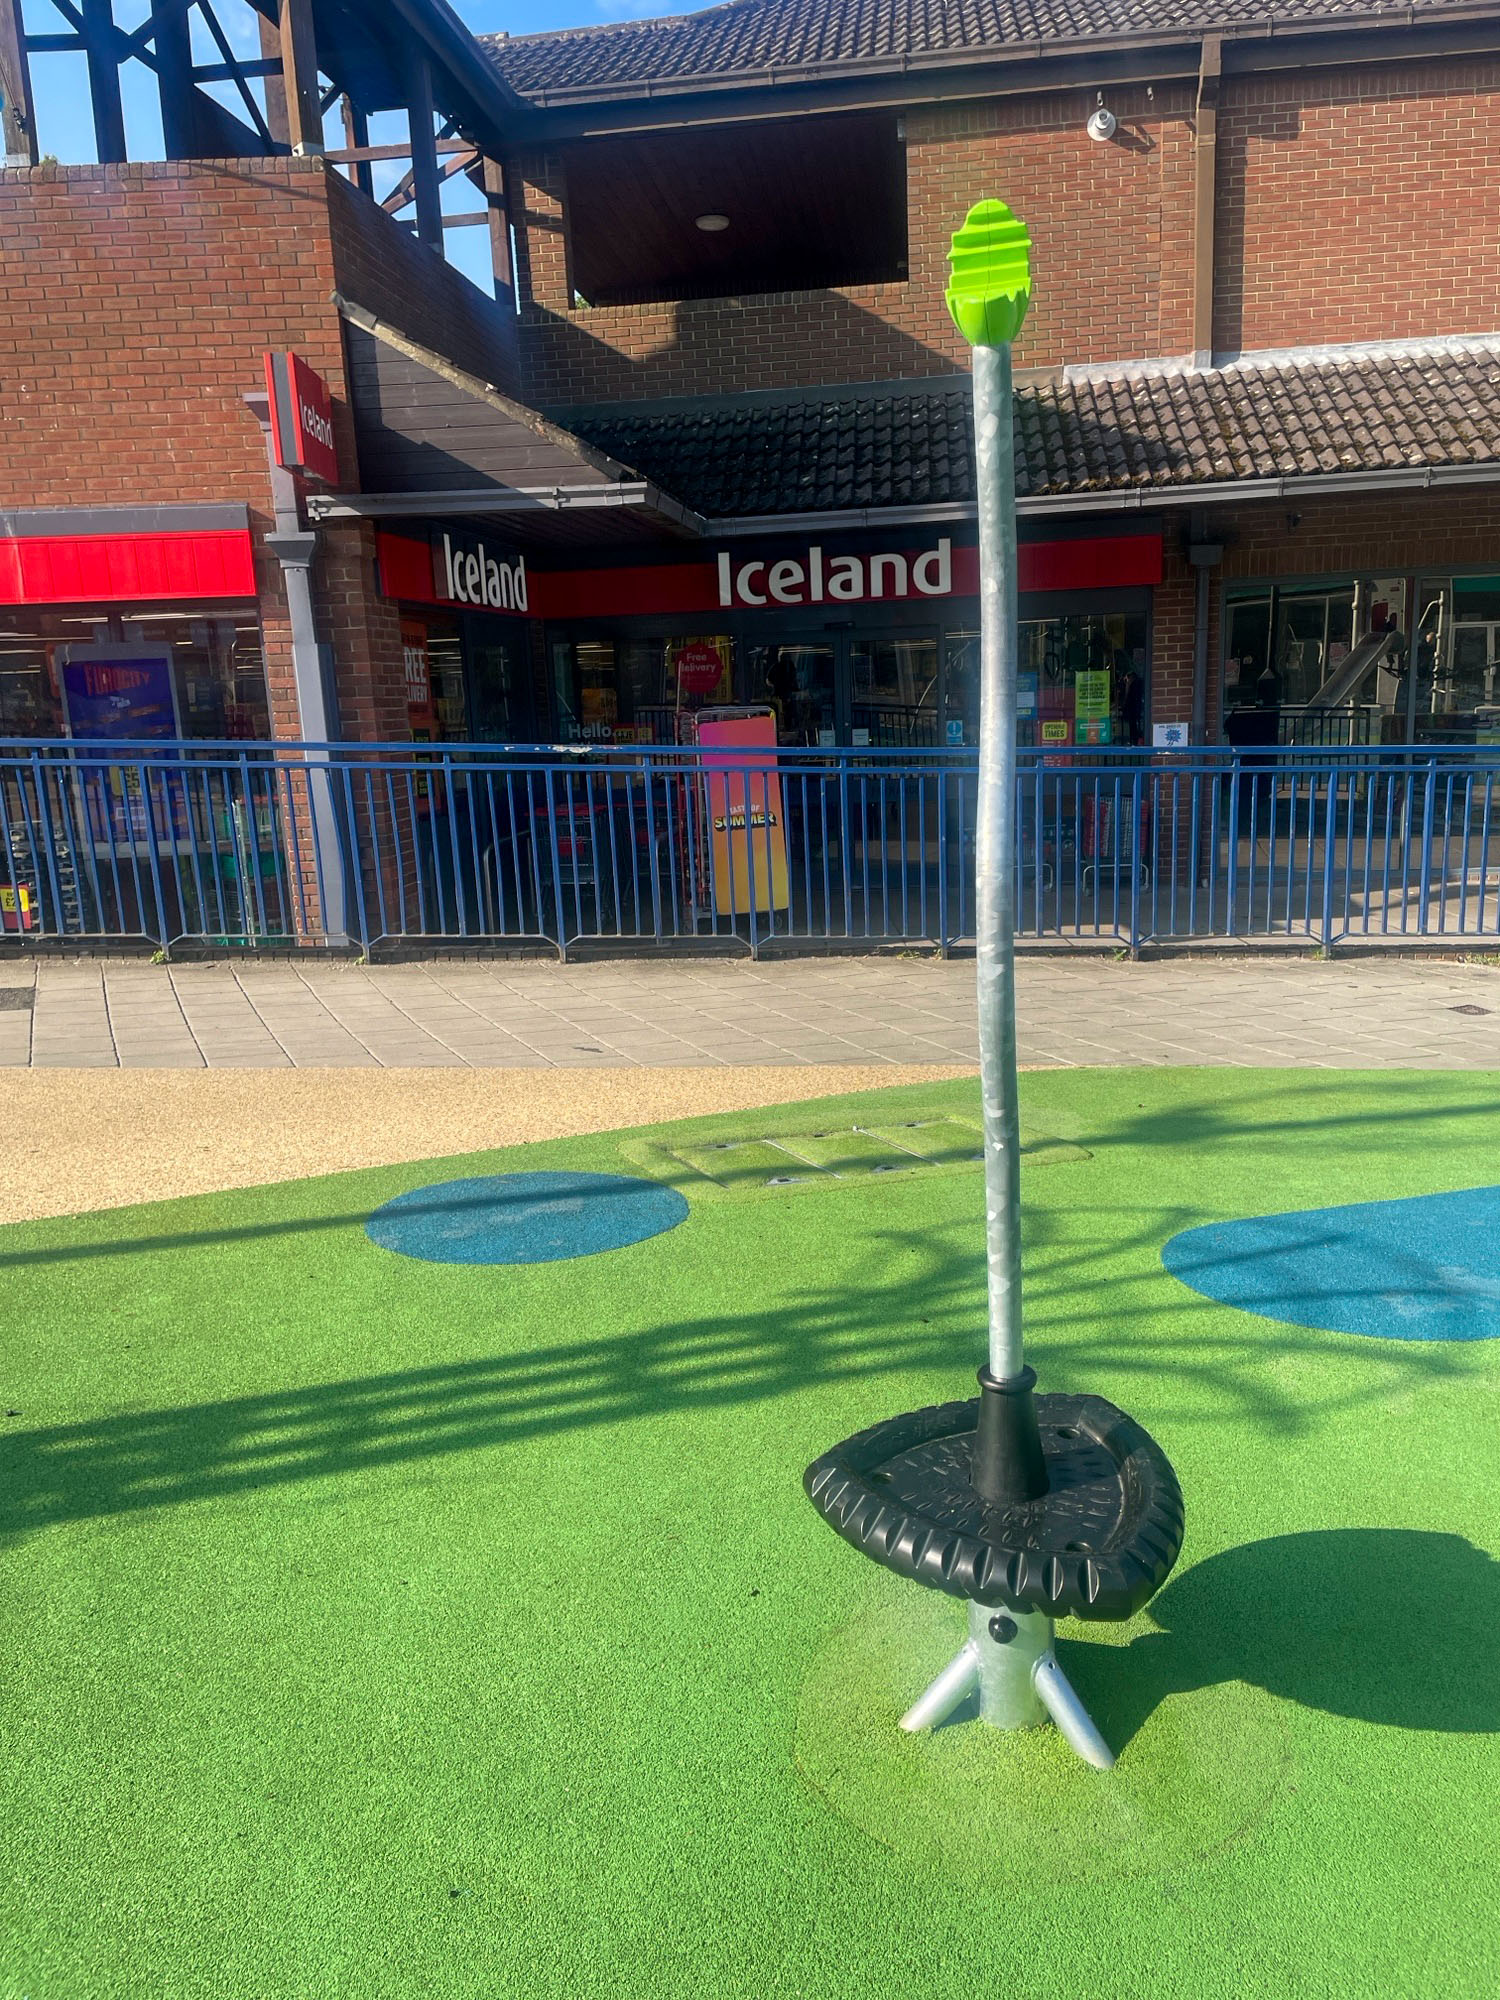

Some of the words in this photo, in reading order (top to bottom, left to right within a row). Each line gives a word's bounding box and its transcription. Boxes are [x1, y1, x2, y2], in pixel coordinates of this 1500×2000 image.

[299, 394, 334, 450] Iceland
[443, 533, 528, 612] Iceland
[718, 538, 952, 606] Iceland
[403, 647, 427, 682] REE
[686, 652, 707, 661] Free
[1045, 730, 1065, 738] TIMES
